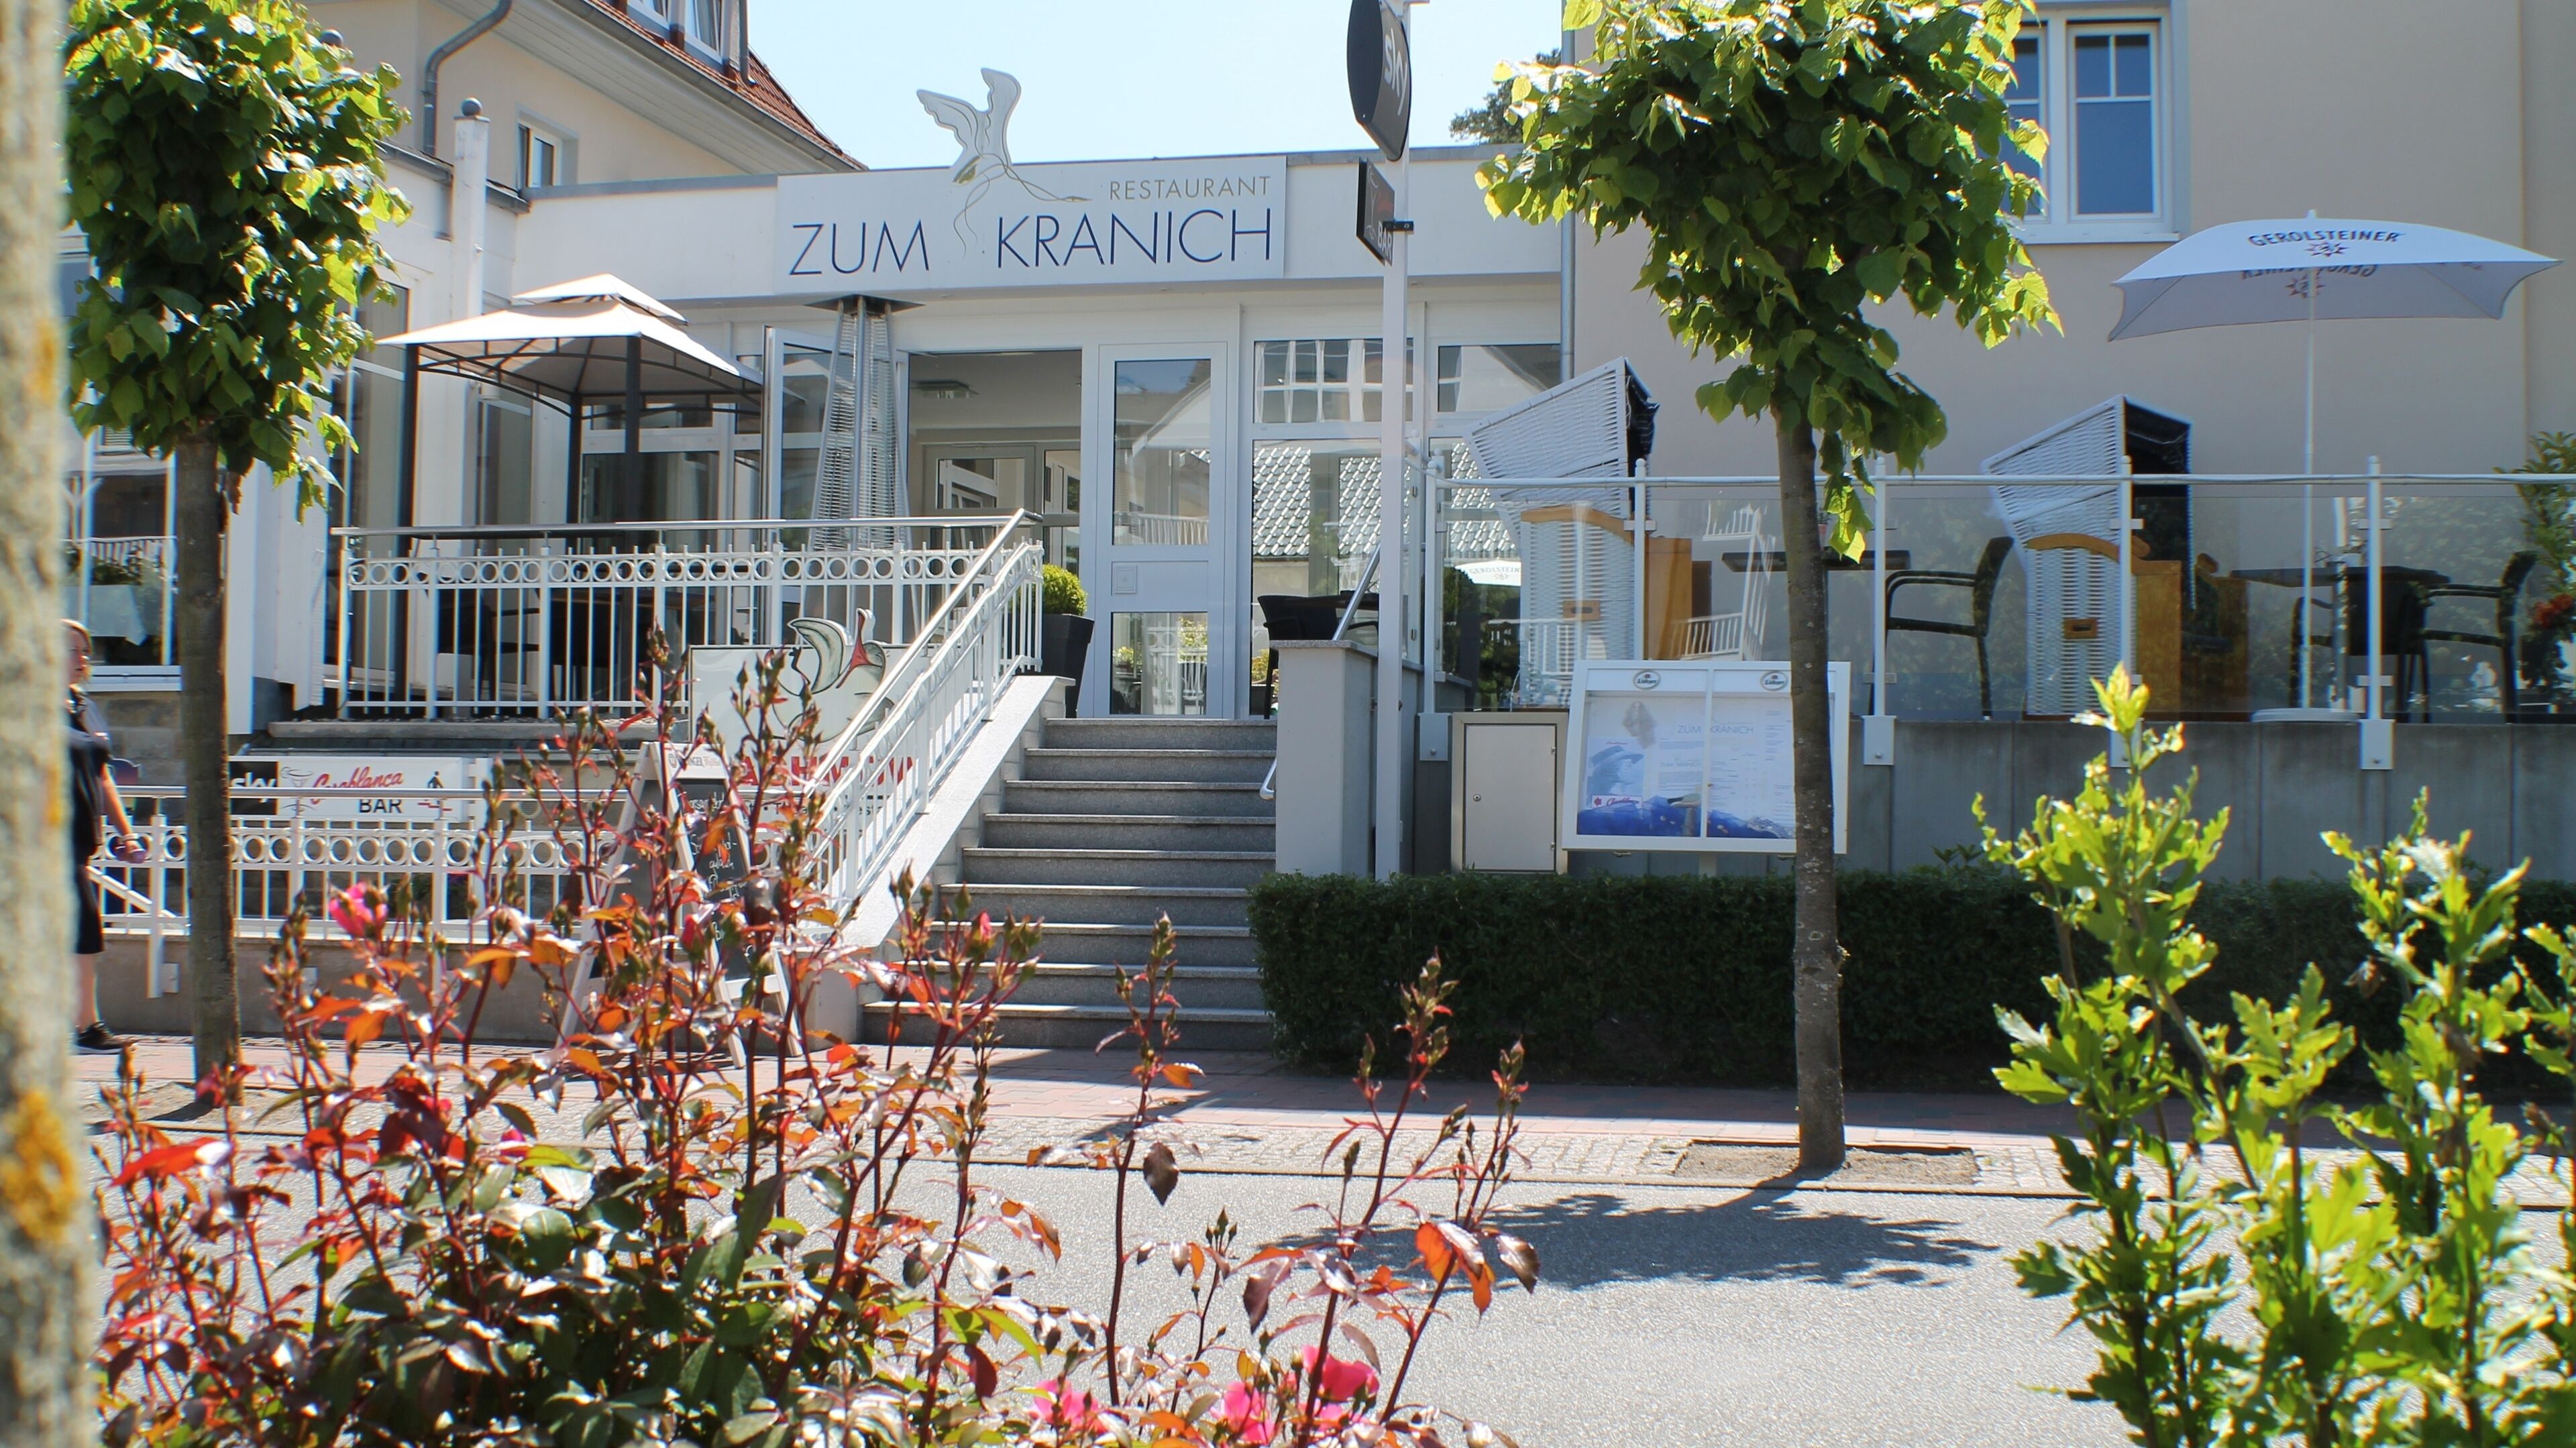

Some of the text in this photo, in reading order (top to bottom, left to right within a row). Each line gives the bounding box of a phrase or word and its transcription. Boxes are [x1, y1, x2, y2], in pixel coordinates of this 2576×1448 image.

[1384, 27, 1407, 116] sky
[1110, 176, 1271, 201] RESTAURANT
[789, 207, 1271, 276] ZUM KRANICH
[1377, 220, 1393, 262] BAR
[2248, 230, 2403, 247] GEROLSTEINER
[1677, 725, 1754, 734] ZUM KRANICH
[358, 799, 403, 814] BAR
